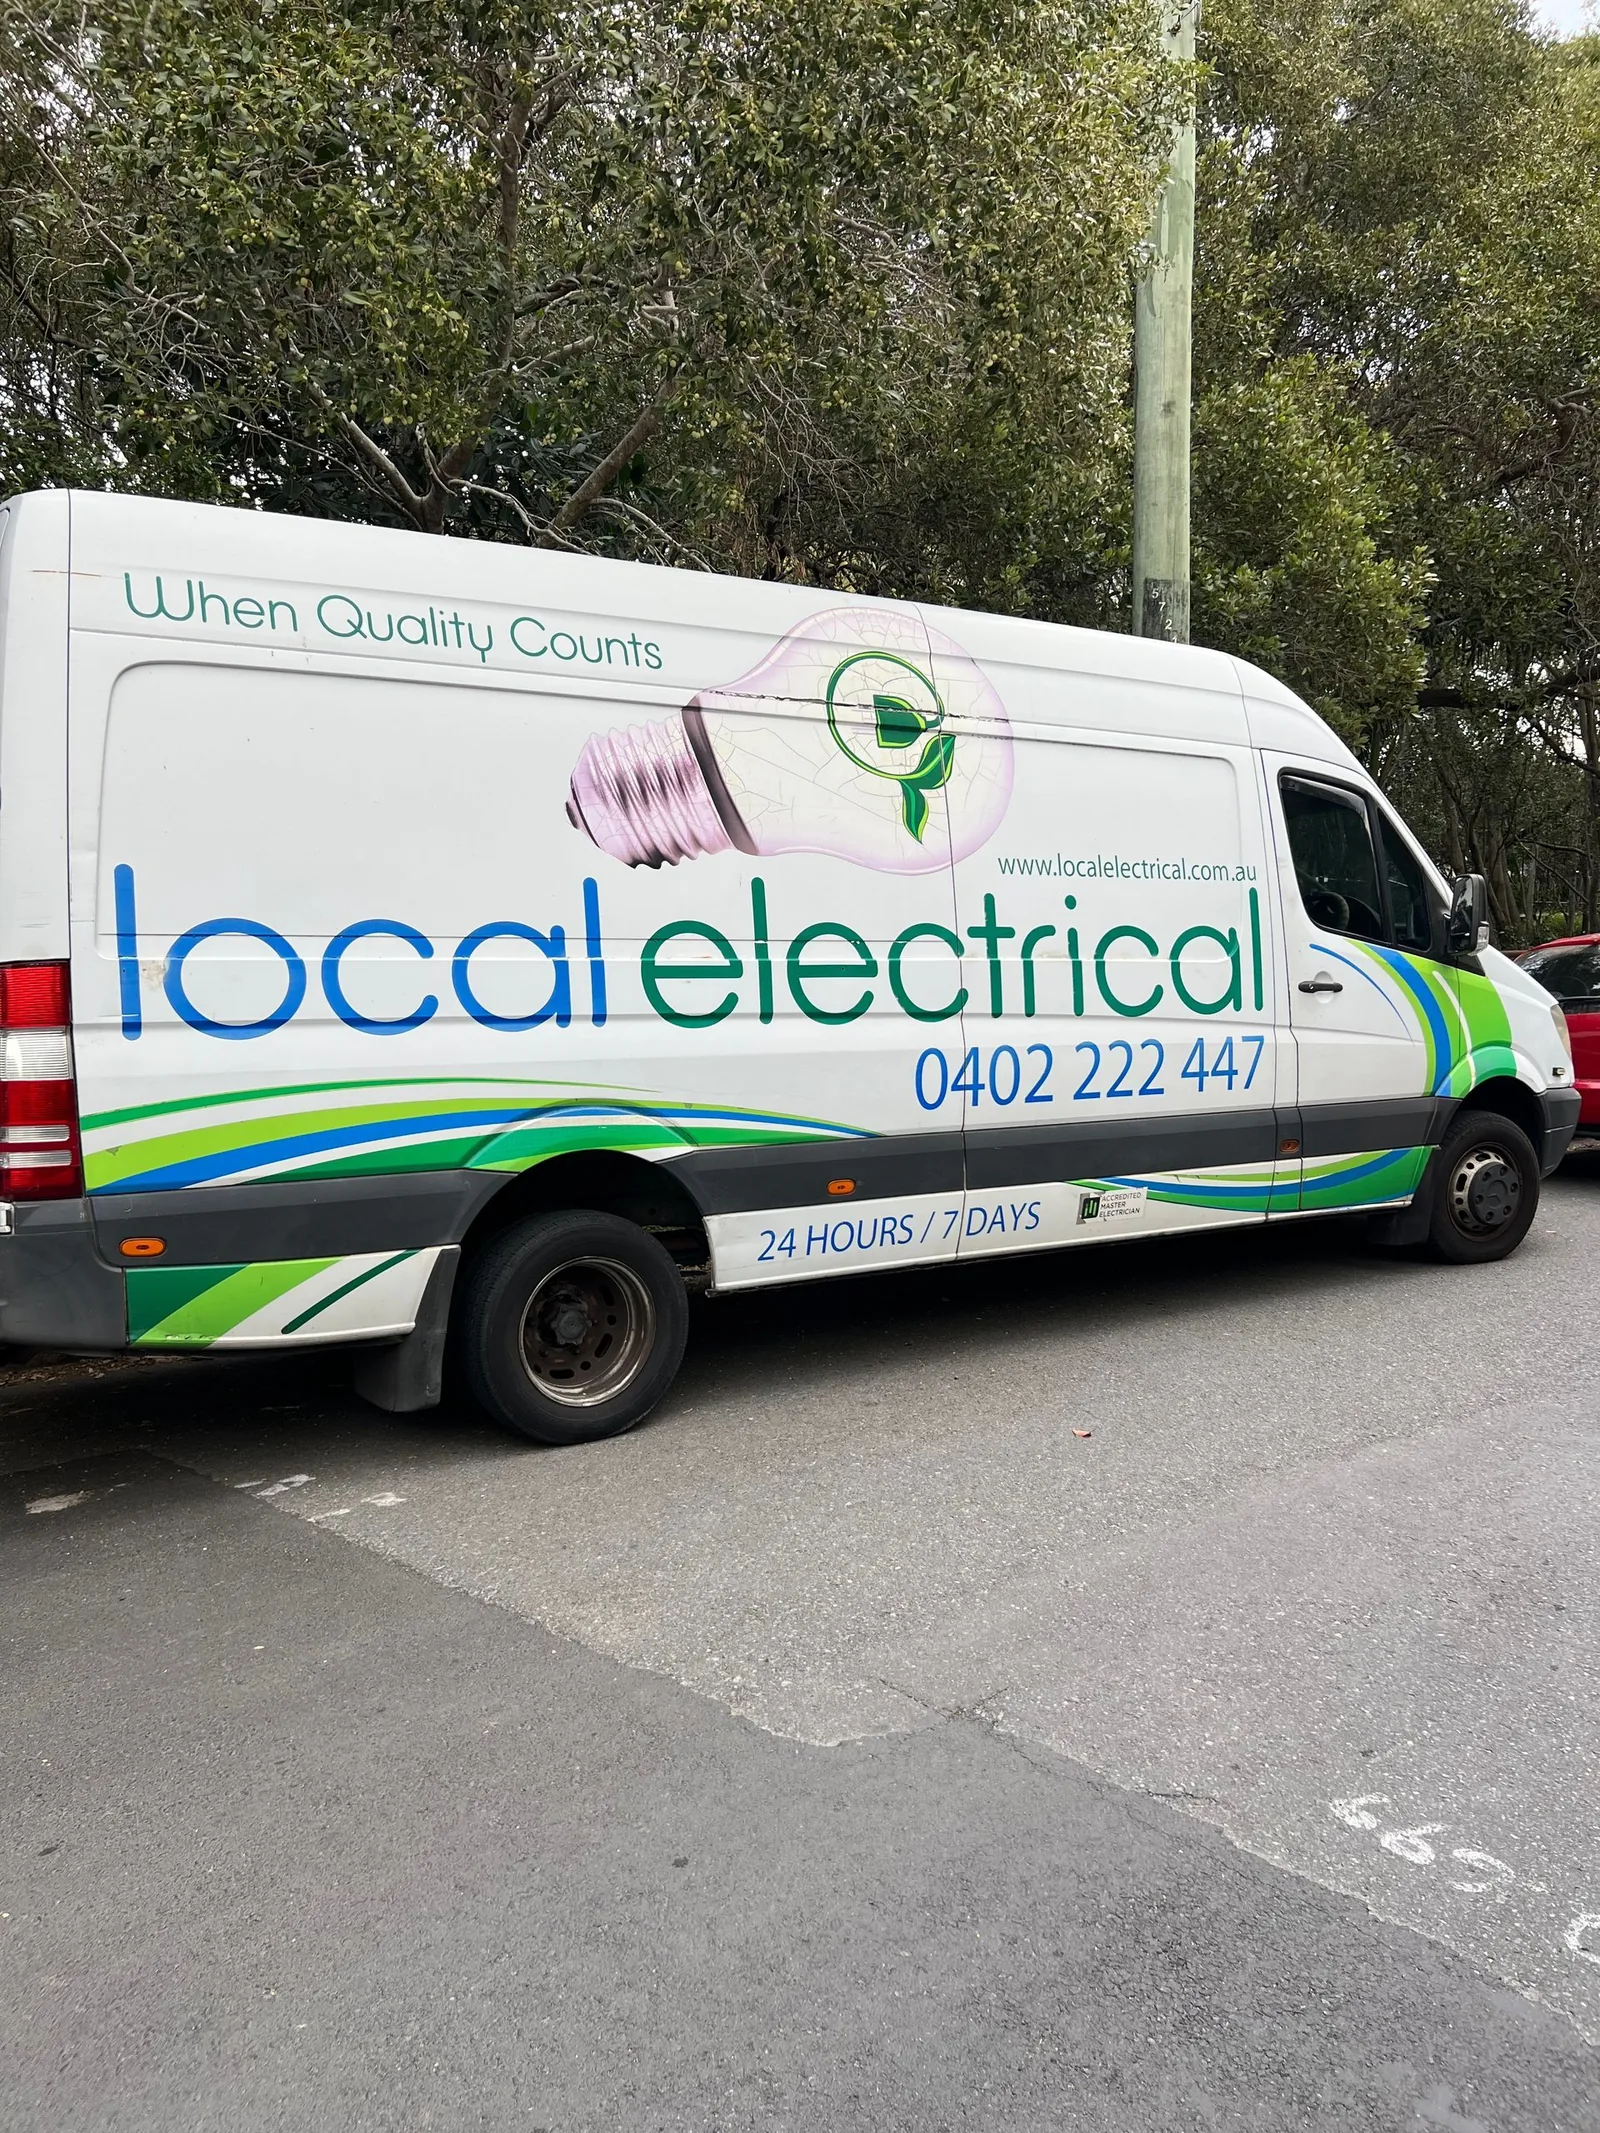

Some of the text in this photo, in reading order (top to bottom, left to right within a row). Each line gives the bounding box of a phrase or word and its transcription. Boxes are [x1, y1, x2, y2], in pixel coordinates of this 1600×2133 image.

[123, 572, 662, 670] When Quality Counts
[998, 853, 1257, 882] www.localelectrical.com.au
[114, 863, 1264, 1041] local electrical
[915, 1035, 1265, 1111] 0402 222 447
[1099, 1207, 1141, 1218] ELECTRICIAN
[1101, 1201, 1127, 1210] MASTER
[1102, 1191, 1142, 1202] ACCREDITED
[757, 1201, 1041, 1262] 24 HOURS / 7 DAYS
